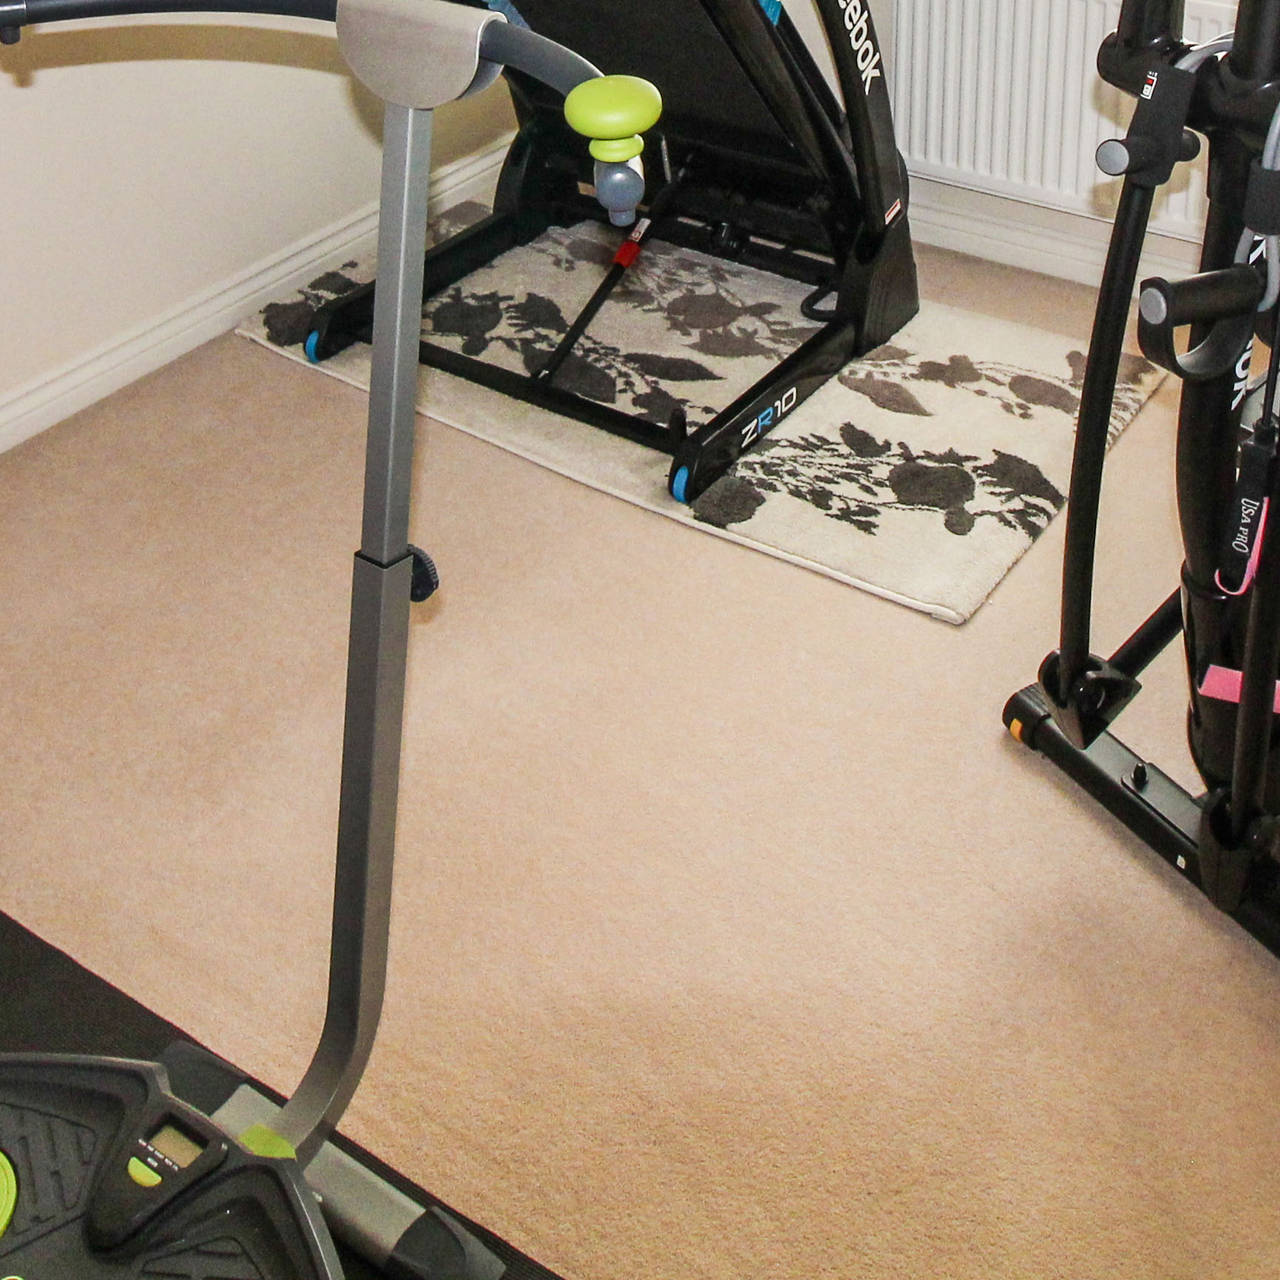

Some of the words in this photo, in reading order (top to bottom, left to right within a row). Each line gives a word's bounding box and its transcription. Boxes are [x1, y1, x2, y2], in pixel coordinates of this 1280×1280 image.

[741, 386, 797, 448] ZR10
[1241, 498, 1260, 524] USA
[1231, 526, 1249, 554] PRO
